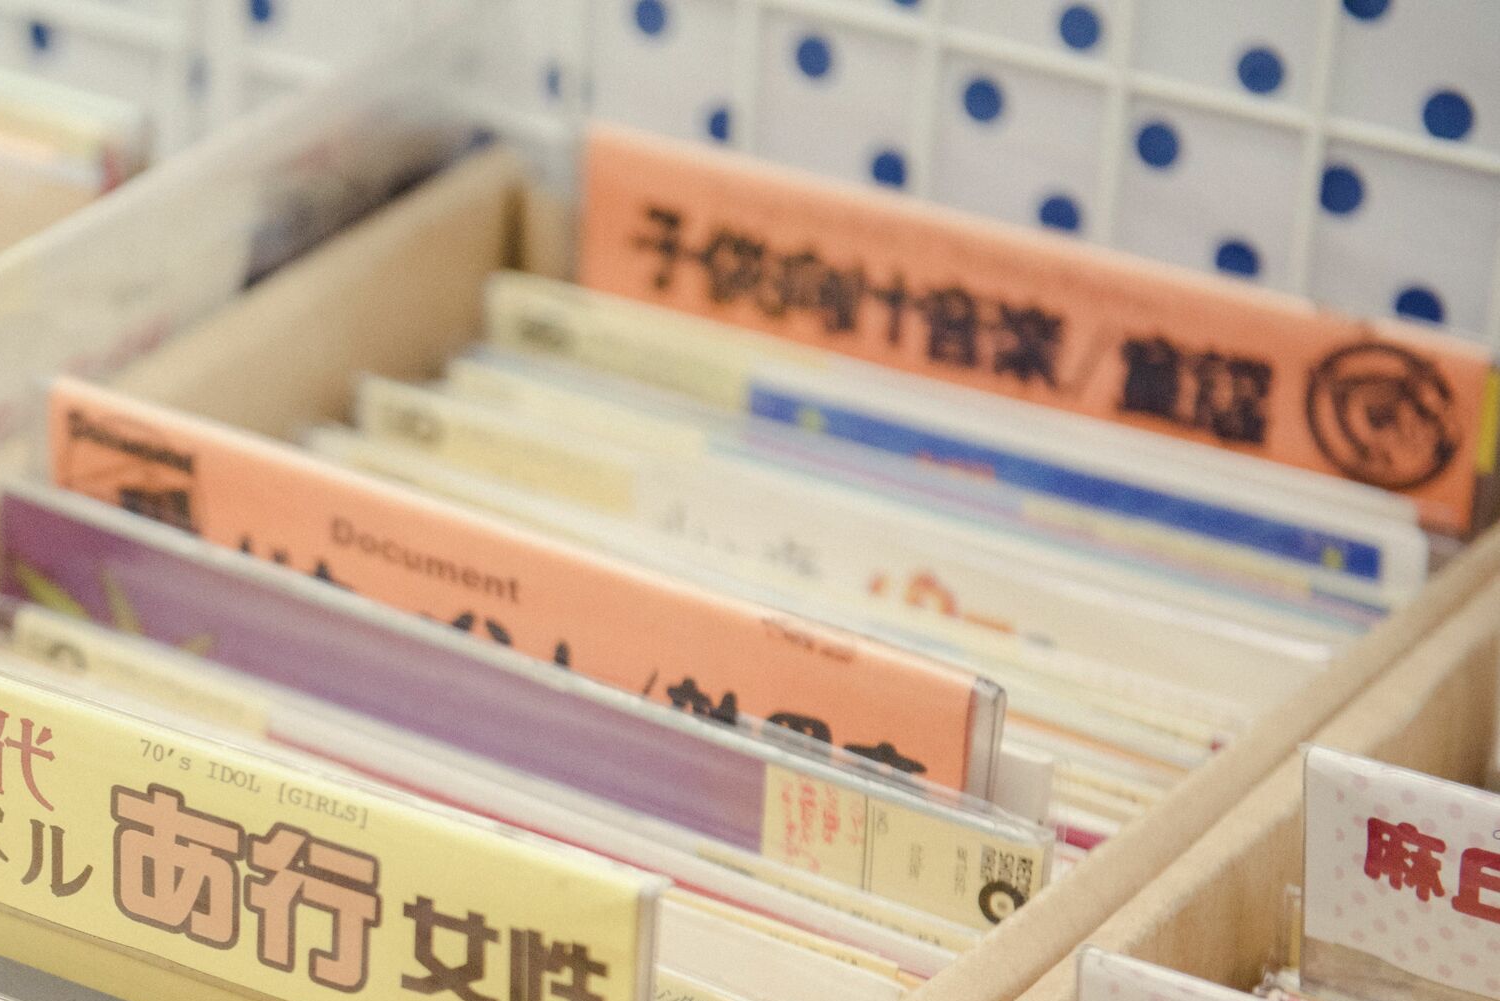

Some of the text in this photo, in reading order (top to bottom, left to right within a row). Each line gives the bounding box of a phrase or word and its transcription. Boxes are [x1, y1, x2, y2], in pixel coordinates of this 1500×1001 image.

[332, 513, 520, 603] Document
[205, 761, 262, 794] IDOL
[110, 782, 383, 995] あ行
